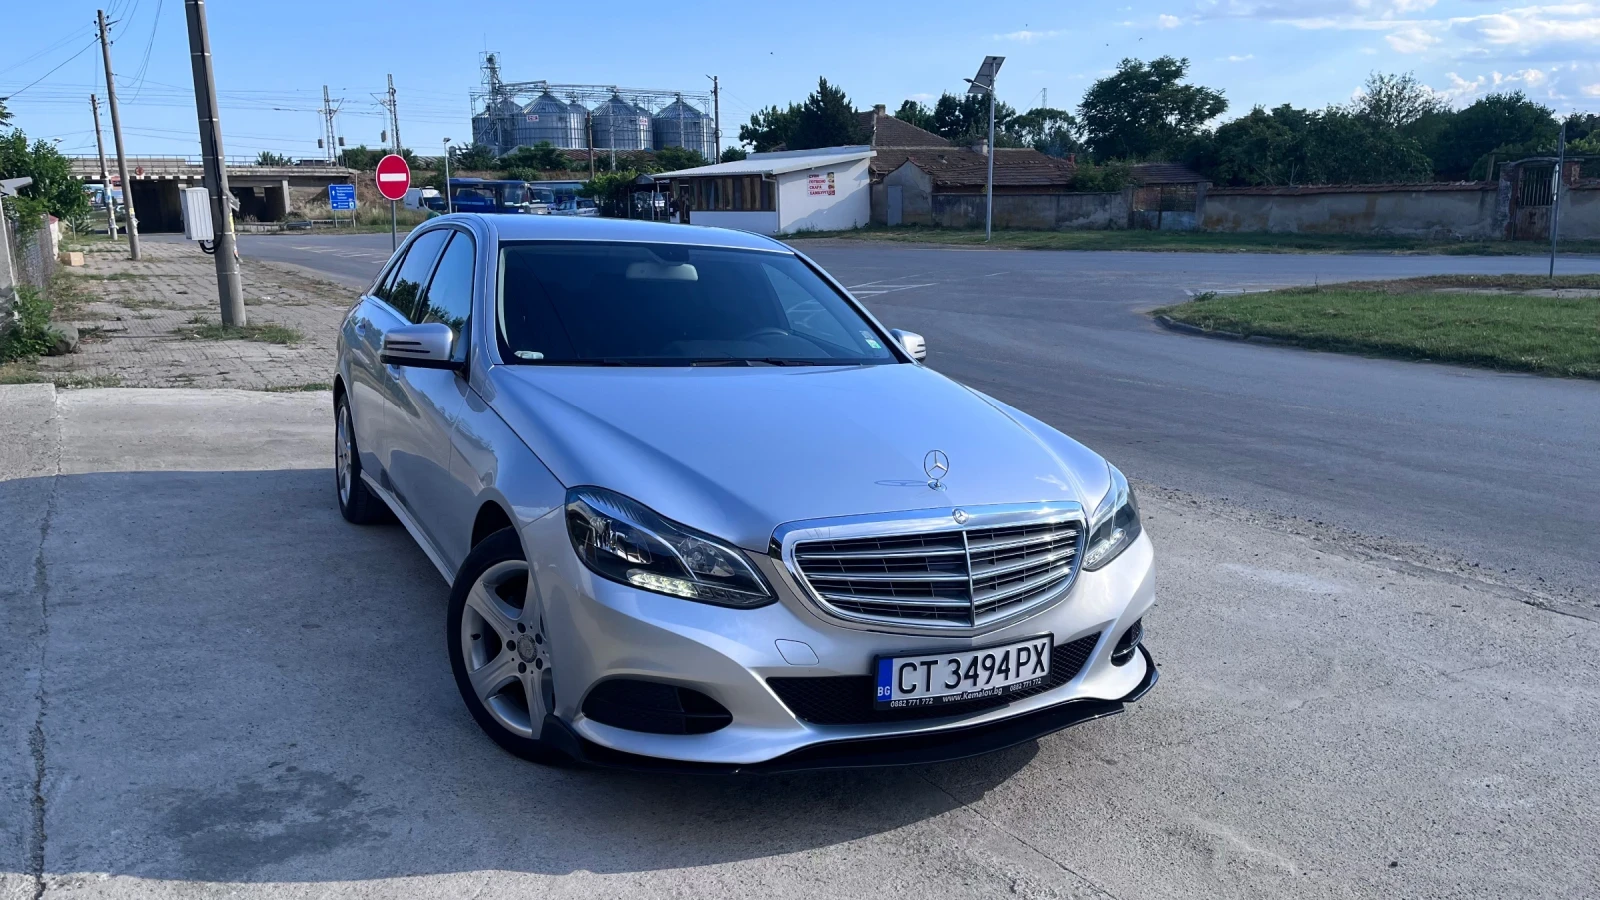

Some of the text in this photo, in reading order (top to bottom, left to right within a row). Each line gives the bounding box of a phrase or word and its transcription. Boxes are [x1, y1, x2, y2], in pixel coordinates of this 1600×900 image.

[899, 642, 1047, 694] CT 3494 PX
[877, 686, 891, 697] BG
[1009, 678, 1042, 692] 0882 771 772
[942, 687, 1003, 703] www.Kemalov.bg
[890, 697, 934, 708] 0882 771 772
